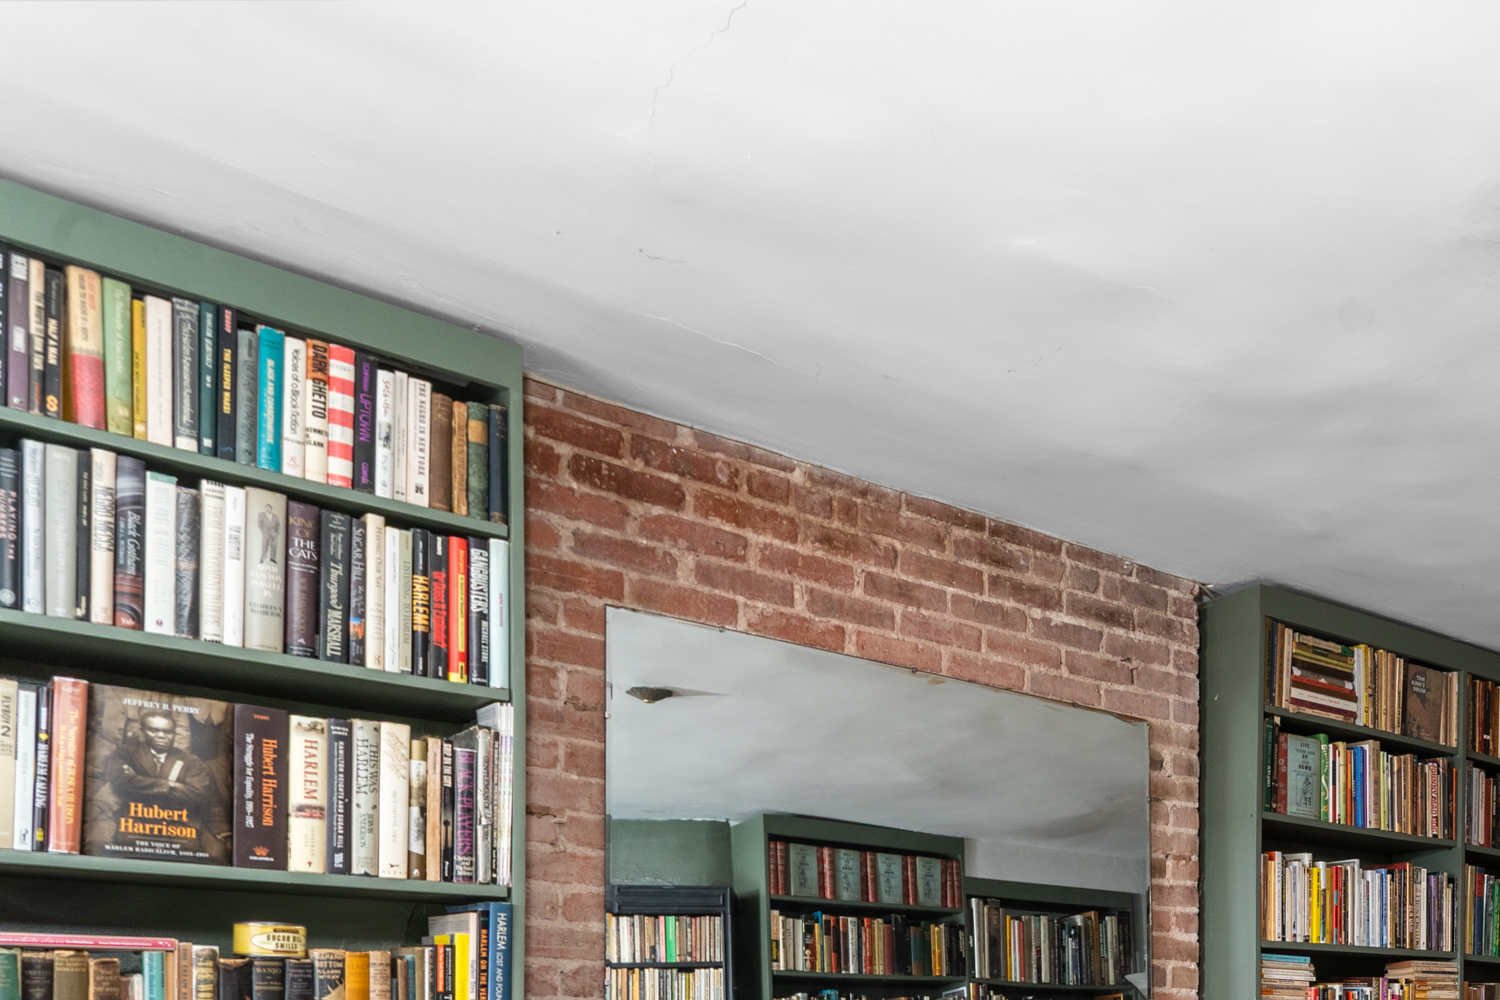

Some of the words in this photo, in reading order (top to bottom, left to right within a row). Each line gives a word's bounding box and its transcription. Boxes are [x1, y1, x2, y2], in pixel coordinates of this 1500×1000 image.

[266, 359, 275, 381] BLACK
[313, 344, 327, 374] DARK
[312, 378, 326, 419] GHETTO
[360, 393, 371, 442] UPTOWN
[8, 490, 17, 541] PLAYING
[94, 484, 114, 518] NEGRO
[126, 511, 140, 538] Black
[126, 539, 140, 574] Gotham
[288, 548, 318, 561] CATS
[292, 537, 316, 551] THE
[352, 526, 364, 560] SUGAR
[328, 561, 342, 609] Thurgood
[352, 560, 364, 582] HILL
[470, 548, 488, 614] GANGBUSTERS
[412, 574, 429, 625] HARLEM
[326, 608, 342, 657] MARSHALL
[2, 695, 12, 724] FLYBOY
[1, 725, 12, 738] 2
[262, 738, 277, 776] Hubert
[304, 738, 318, 800] HARLEM
[356, 738, 368, 796] HARLEM
[369, 742, 378, 768] THIS
[369, 770, 378, 794] WAS
[458, 752, 474, 794] BLACK
[129, 802, 188, 822] Hubert
[262, 778, 276, 826] Harrison
[120, 817, 197, 838] Harrison
[458, 796, 474, 856] PLAYERS
[198, 960, 214, 980] THE
